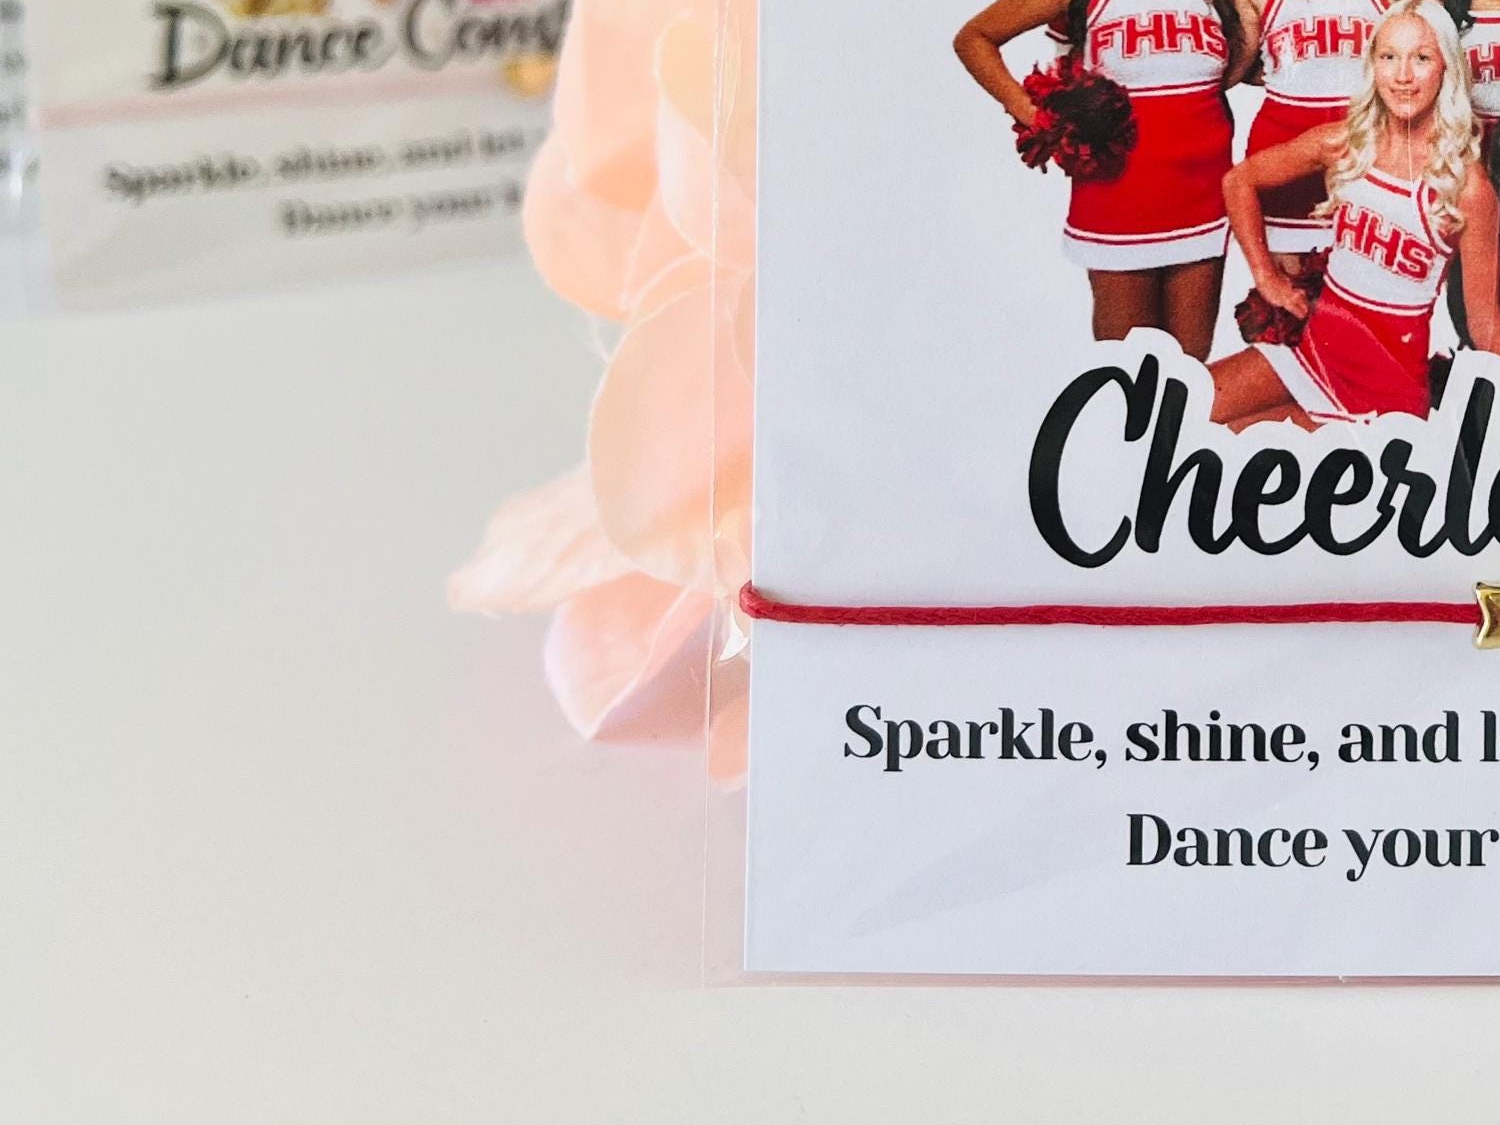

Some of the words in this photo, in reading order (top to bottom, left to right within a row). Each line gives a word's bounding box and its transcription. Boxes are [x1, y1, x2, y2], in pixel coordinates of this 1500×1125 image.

[1086, 10, 1229, 68] FHHS
[1264, 15, 1376, 74] FHH
[1335, 201, 1437, 283] HHS
[844, 704, 1107, 773] Sparkle,
[1125, 709, 1320, 772] shine,
[1338, 710, 1462, 764] and
[1126, 813, 1328, 868] Dance
[1341, 828, 1500, 883] your
